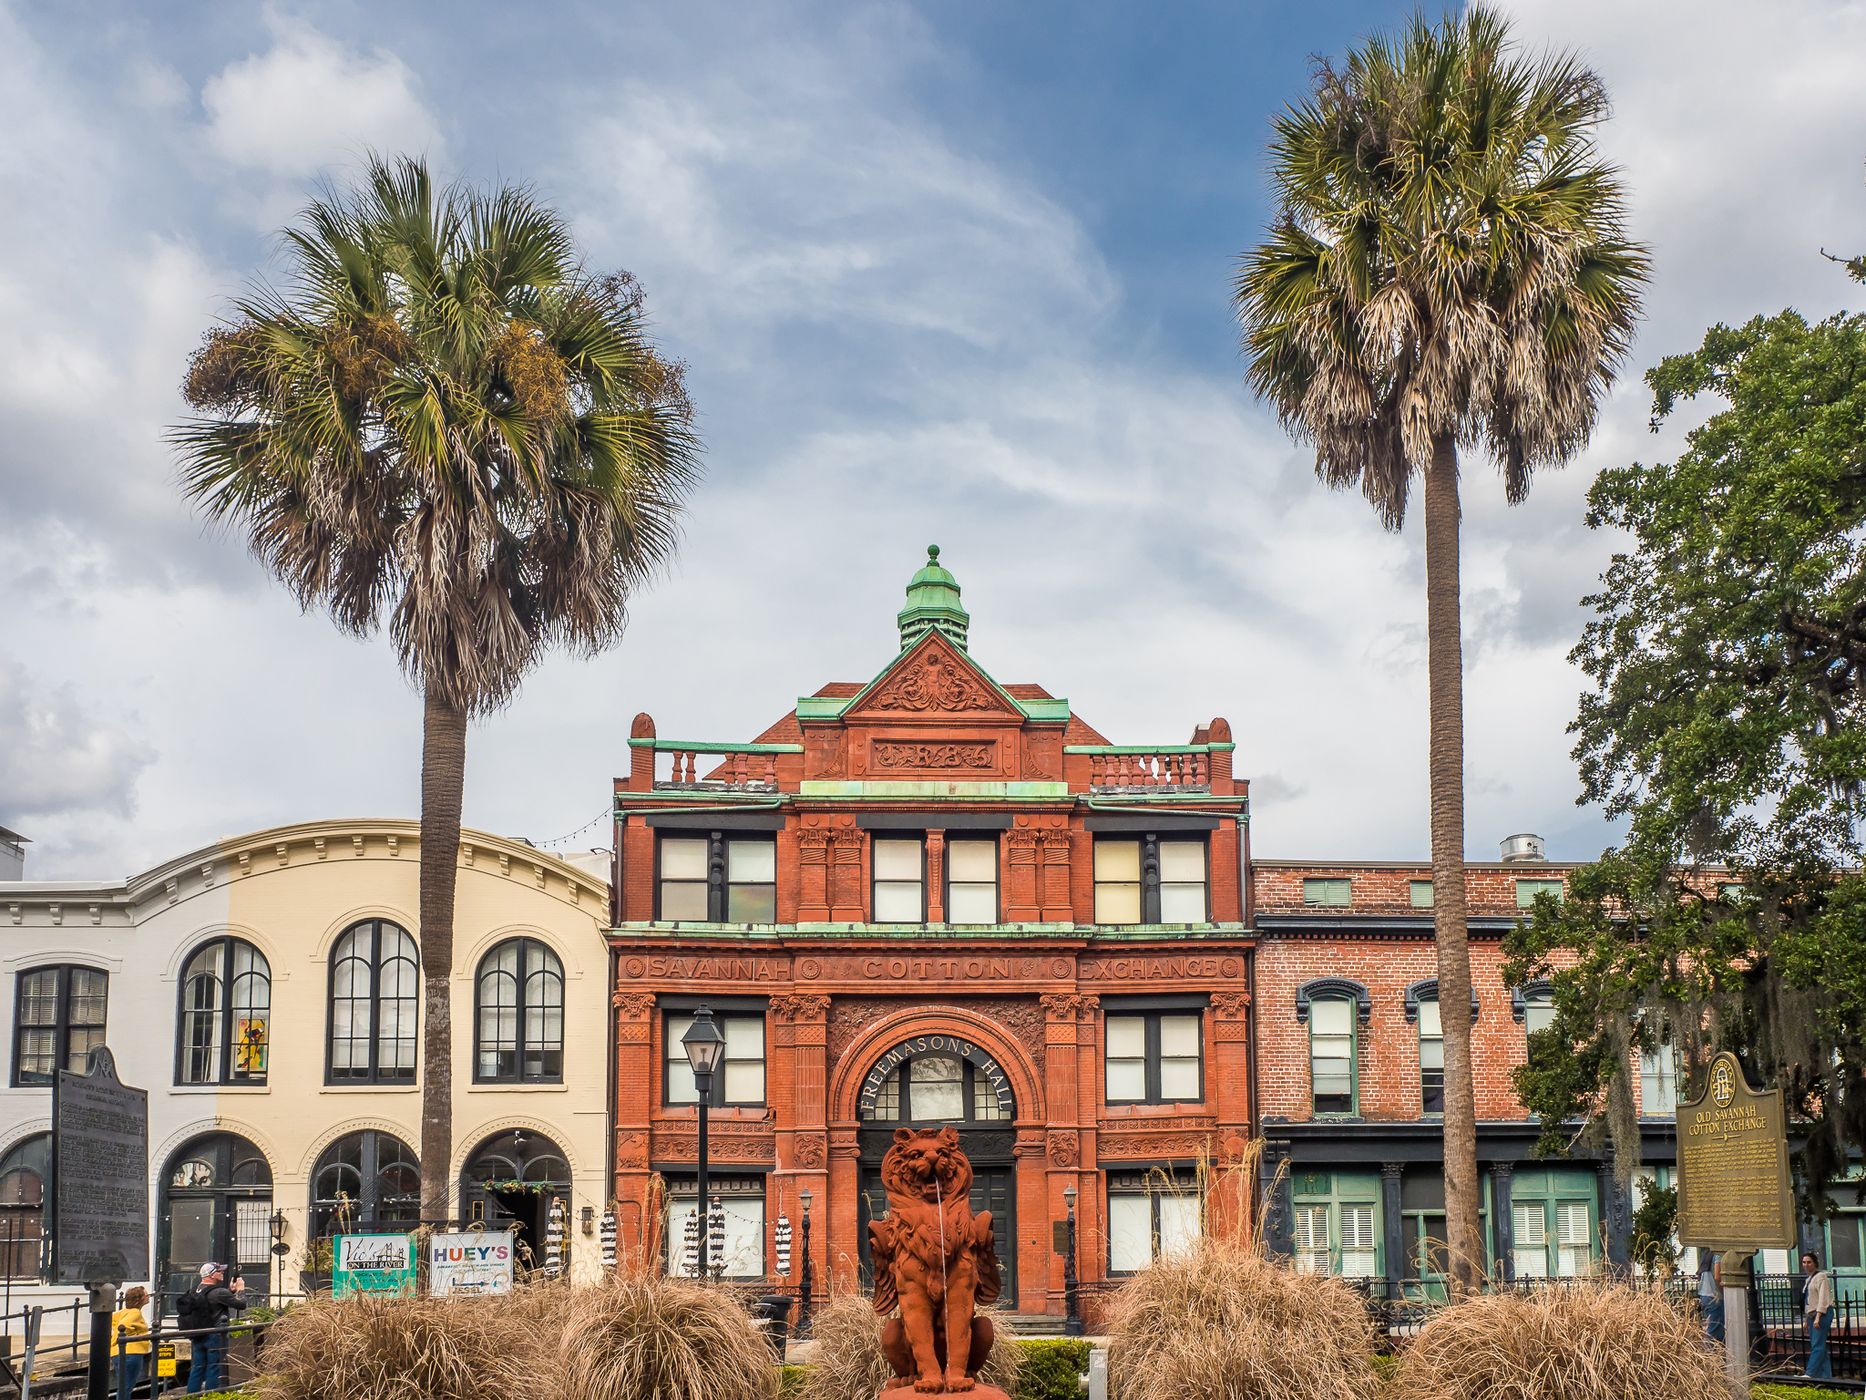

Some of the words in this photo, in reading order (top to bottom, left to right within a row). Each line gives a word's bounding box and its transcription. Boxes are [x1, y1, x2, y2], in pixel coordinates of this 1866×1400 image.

[649, 957, 793, 981] SAVANNAH
[862, 959, 1011, 979] COTTON
[1078, 957, 1218, 980] EXCHANGE
[860, 1036, 978, 1112] FREEMASONS'
[980, 1059, 1013, 1111] HALL
[1696, 1111, 1711, 1123] OLD
[1715, 1105, 1757, 1121] SAVANNAH
[1688, 1121, 1720, 1136] COTTON
[1724, 1116, 1767, 1133] EXCHANGE
[343, 1238, 377, 1261] Vic's
[434, 1246, 509, 1262] HUEY'S
